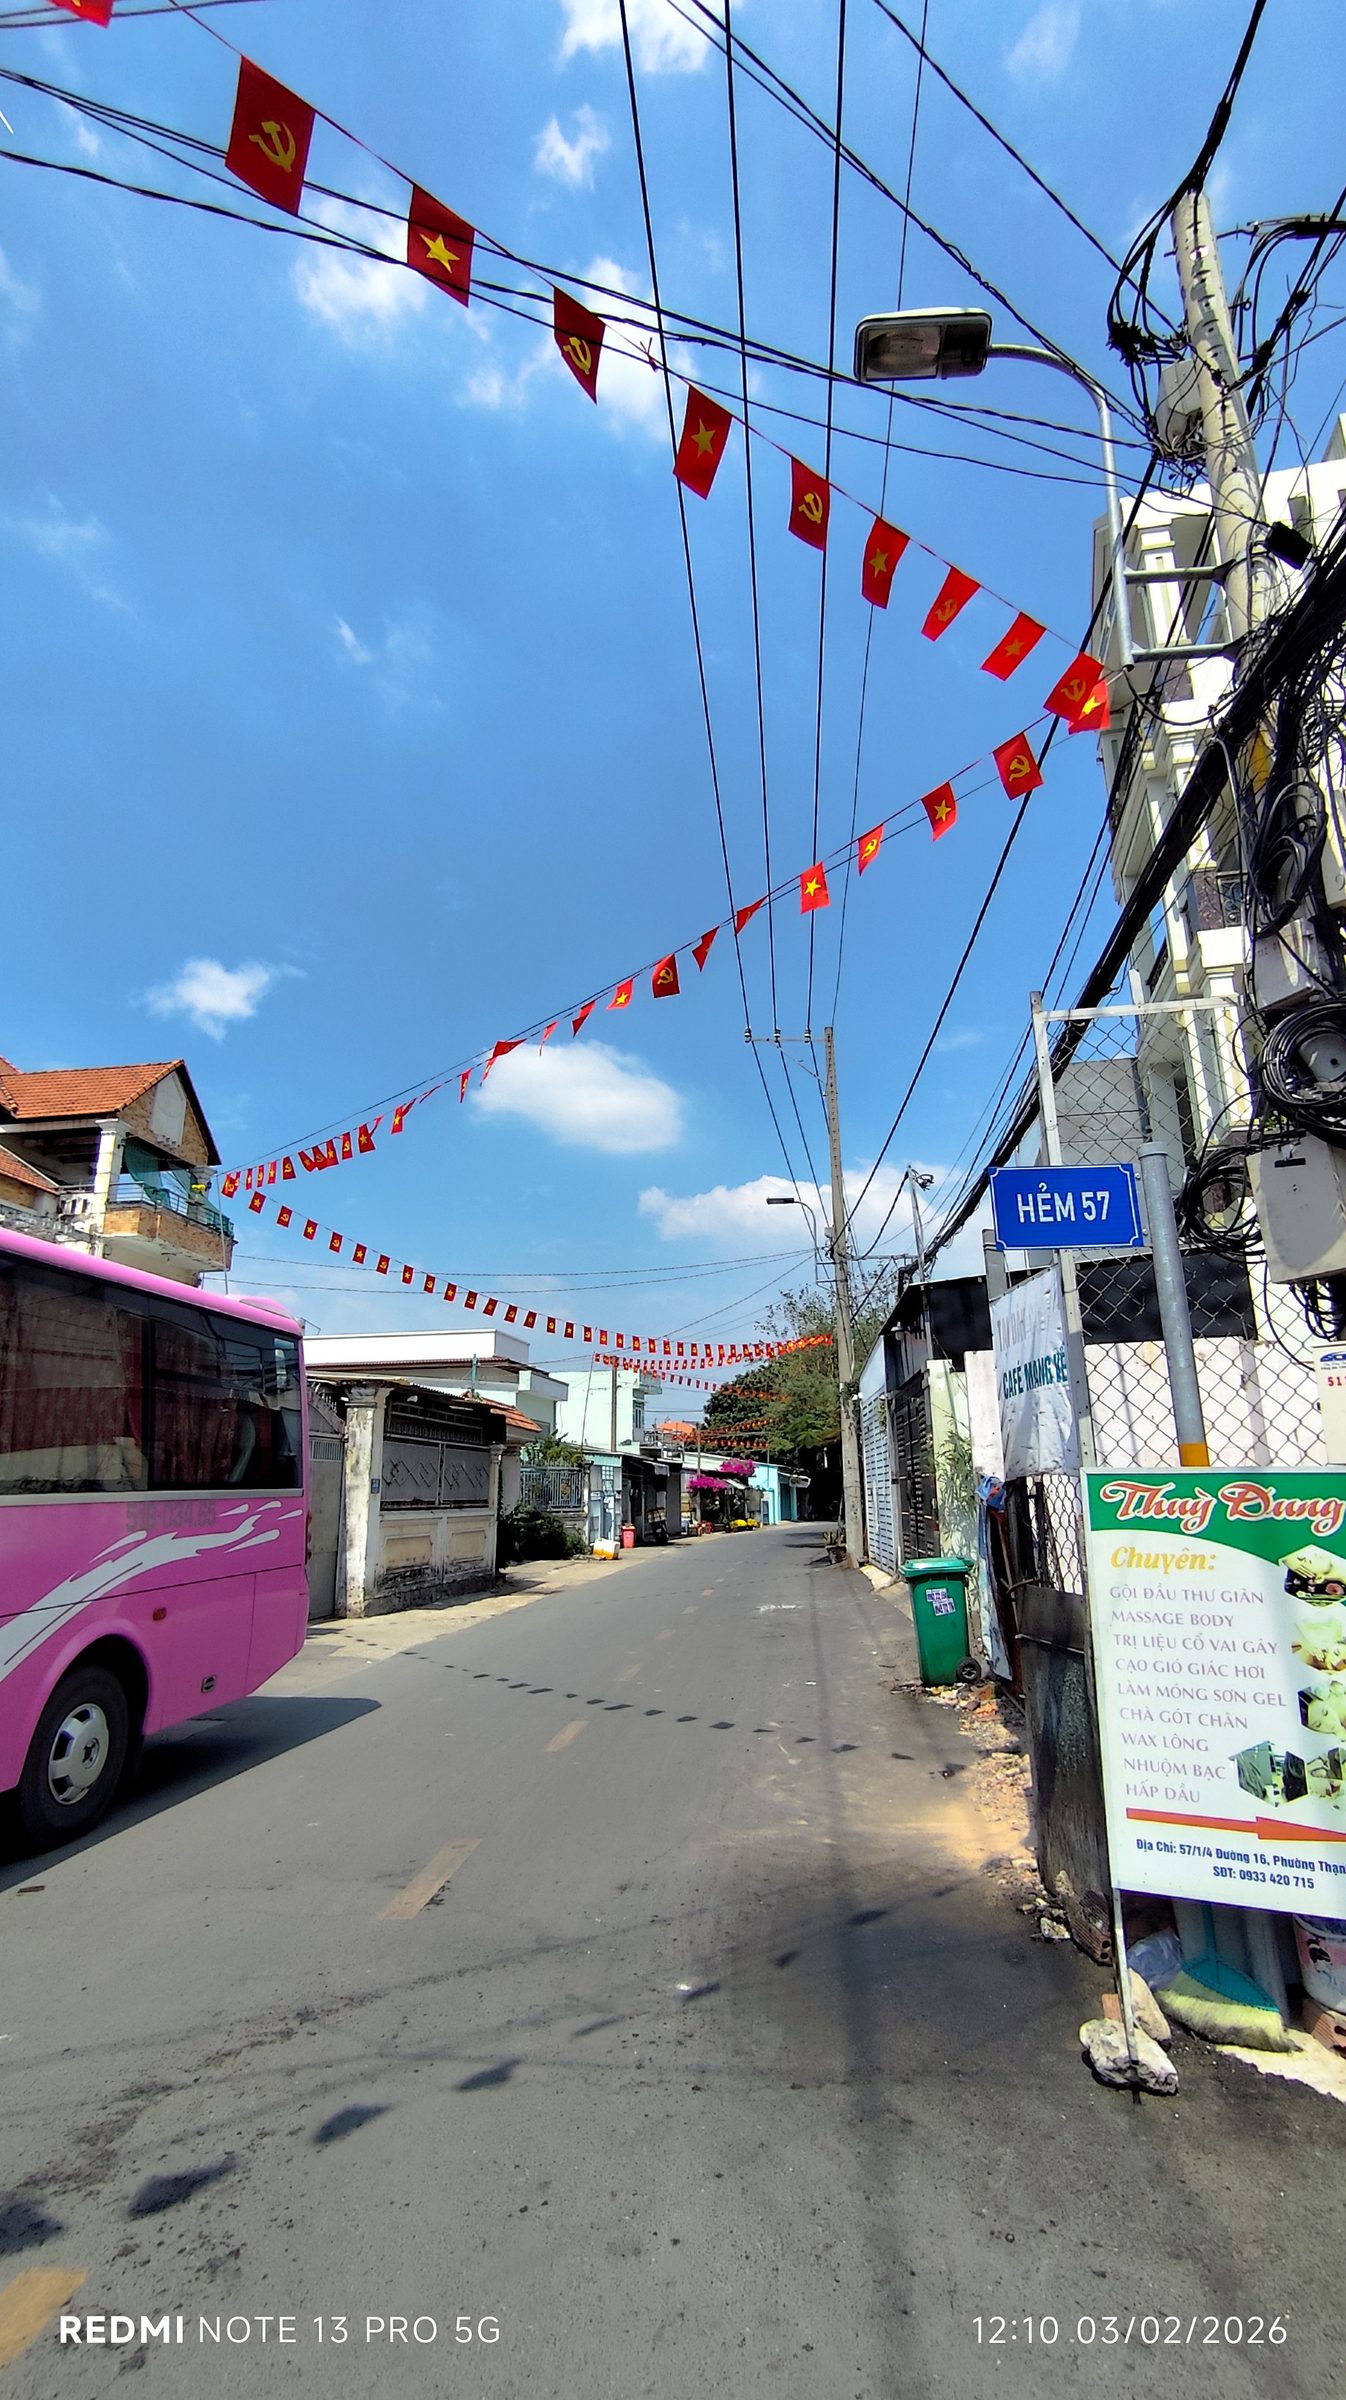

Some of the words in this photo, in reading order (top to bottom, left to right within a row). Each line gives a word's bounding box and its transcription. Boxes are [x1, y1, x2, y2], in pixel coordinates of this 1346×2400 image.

[1017, 1183, 1075, 1223] HẺM
[1082, 1191, 1109, 1220] 57
[1024, 1355, 1053, 1390] MANG
[1328, 1376, 1346, 1386] 51
[1111, 1547, 1217, 1574] Chuyên:
[1110, 1584, 1137, 1601] GỘI
[1143, 1583, 1176, 1600] ĐẦU
[1182, 1589, 1215, 1602] THƯ
[1112, 1610, 1184, 1625] MASSAGE
[1190, 1614, 1233, 1627] BODY
[1114, 1634, 1137, 1649] TRỊ
[1143, 1634, 1177, 1651] LIỆU
[1182, 1633, 1204, 1650] CỔ
[1210, 1639, 1236, 1652] VAI
[1243, 1638, 1278, 1654] GÁY
[1115, 1658, 1147, 1674] CẠO
[1153, 1658, 1182, 1673] GIÓ
[1188, 1660, 1228, 1677] GIÁC
[1235, 1665, 1265, 1679] HƠI
[1118, 1677, 1150, 1696] LÀM
[1156, 1684, 1208, 1701] MÓNG
[1214, 1689, 1246, 1703] SƠN
[1253, 1692, 1287, 1706] GEL
[1120, 1706, 1154, 1722] CHÀ
[1159, 1709, 1192, 1725] GÓT
[1198, 1712, 1247, 1729] CHÂN
[1122, 1733, 1157, 1747] WAX
[1163, 1734, 1208, 1752] LÔNG
[1124, 1758, 1187, 1777] NHUỘM
[1193, 1764, 1226, 1781] BẠC
[1126, 1779, 1158, 1797] HẤP
[1165, 1783, 1200, 1803] DẦU
[1136, 1839, 1153, 1852] Địa
[1179, 1844, 1212, 1857] 57/1/4
[1216, 1848, 1249, 1864] Đường
[1254, 1853, 1270, 1866] 16,
[1273, 1856, 1315, 1872] Phường
[1318, 1861, 1346, 1876] Thạn
[1213, 1866, 1236, 1879] SĐT:
[1239, 1869, 1266, 1882] 0933
[1270, 1873, 1289, 1886] 420
[1294, 1876, 1314, 1889] 715
